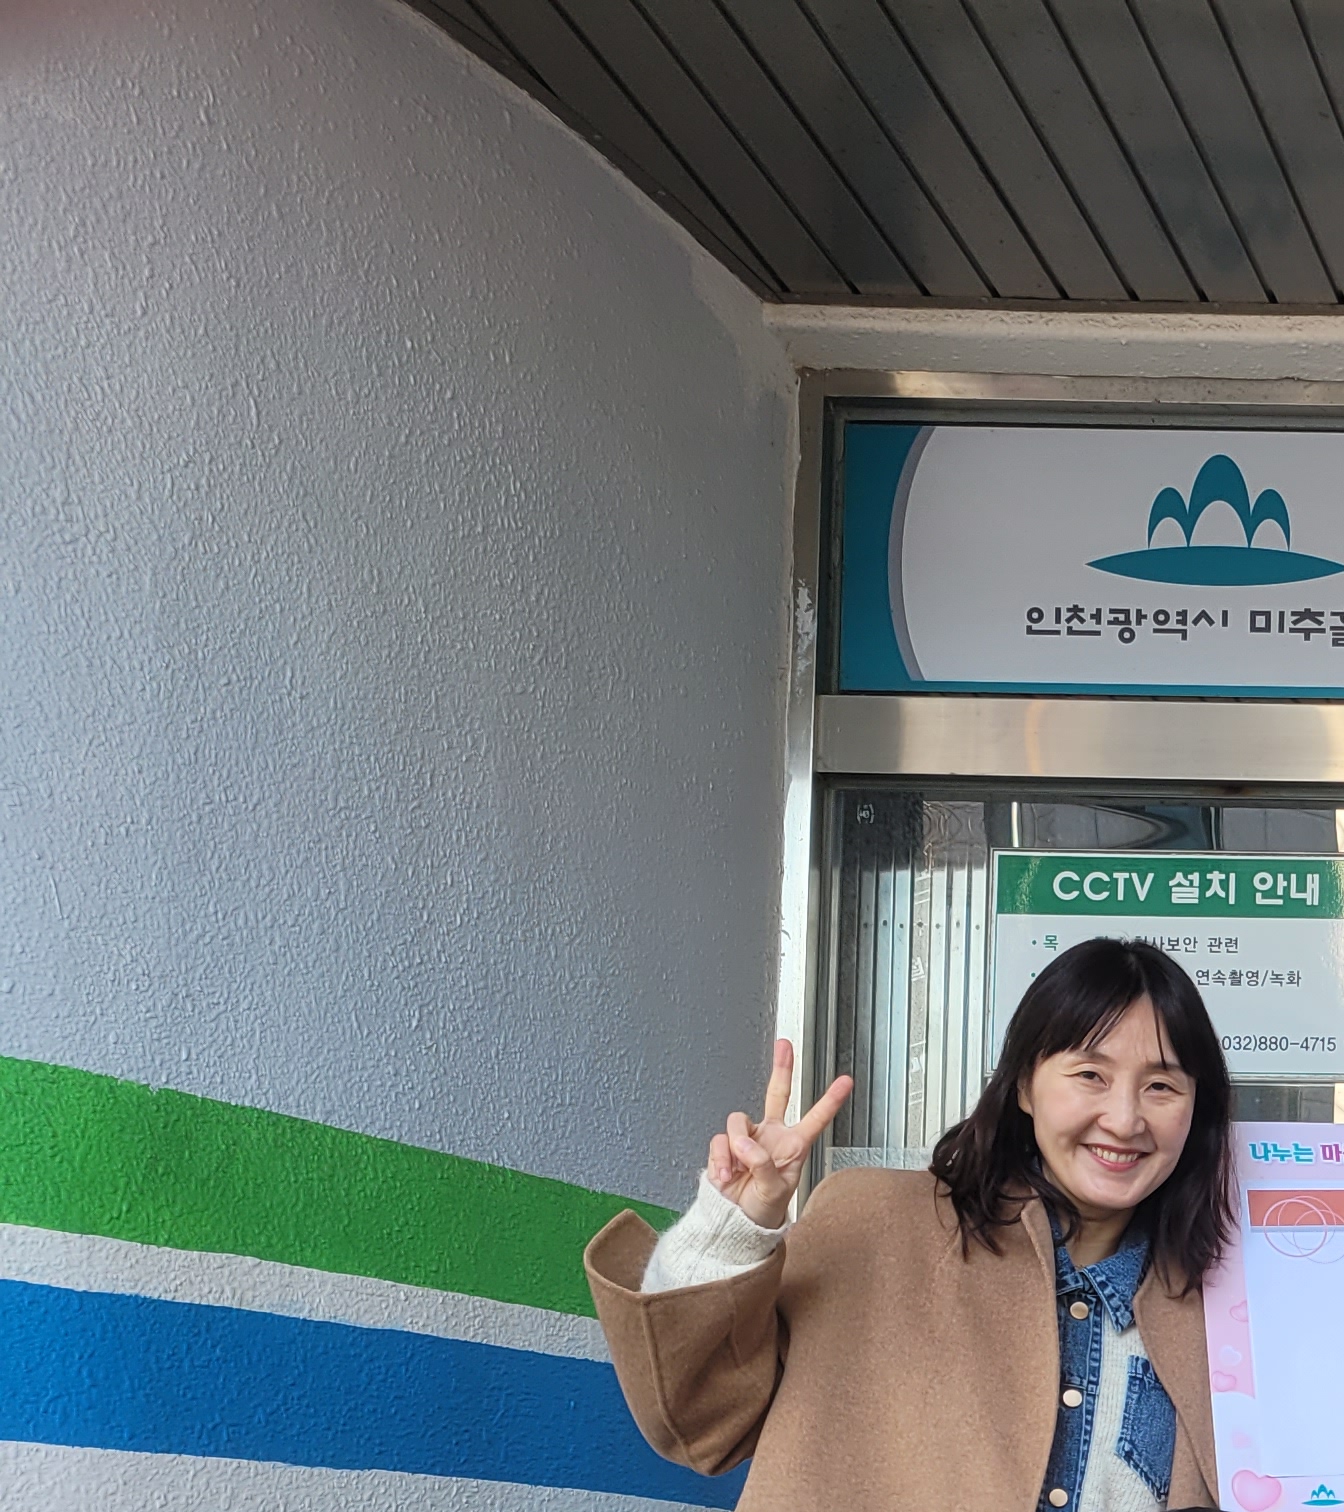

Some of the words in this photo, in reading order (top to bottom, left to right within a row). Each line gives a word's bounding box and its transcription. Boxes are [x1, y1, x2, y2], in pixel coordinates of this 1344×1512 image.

[1025, 605, 1230, 644] 인천광역시
[1053, 871, 1154, 902] CCTV
[1168, 871, 1237, 906] 설치
[1252, 872, 1321, 907] 안내
[1043, 935, 1059, 951] 목
[1207, 936, 1240, 954] 관련
[1195, 969, 1302, 988] 연속촬영/녹화
[1221, 1034, 1337, 1053] 032)880-4715
[1248, 1142, 1314, 1164] 나누는
